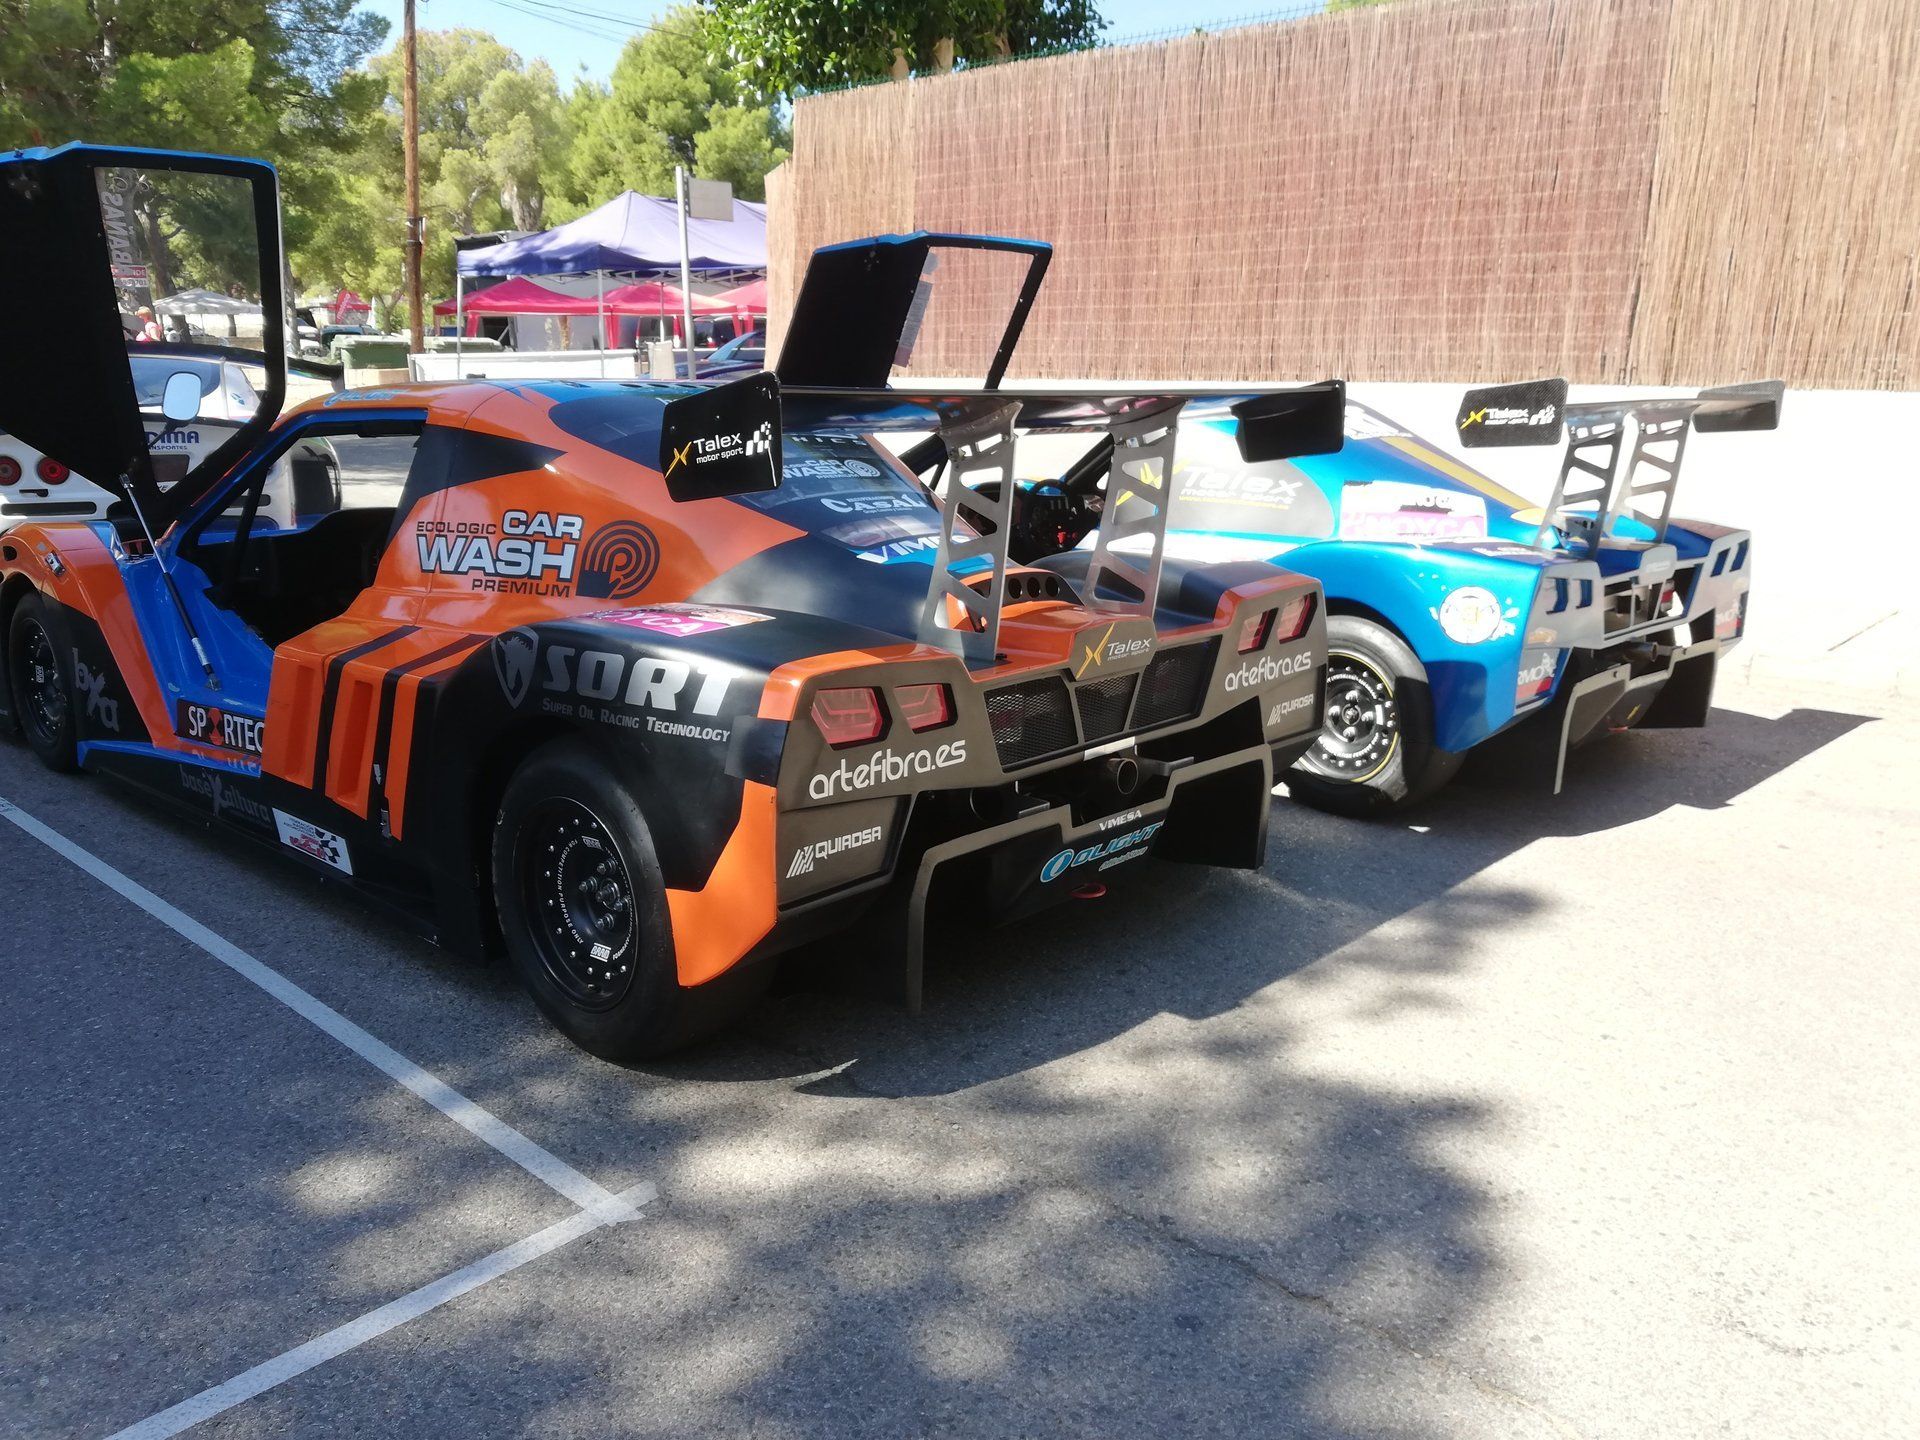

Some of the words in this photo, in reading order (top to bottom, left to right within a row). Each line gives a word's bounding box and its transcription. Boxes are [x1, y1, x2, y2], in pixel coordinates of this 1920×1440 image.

[693, 433, 742, 454] Talex
[696, 453, 720, 464] motor
[721, 447, 744, 459] sport
[1184, 466, 1303, 497] Talex
[416, 521, 497, 535] ECOLOGIC
[502, 509, 584, 541] CAR
[416, 533, 578, 582] WASH
[471, 578, 570, 598] PREMIUM
[1108, 638, 1152, 656] Talex
[542, 645, 742, 717] SORT
[1225, 651, 1311, 692] artefibra.es
[809, 740, 966, 799] artefibra.es
[1099, 810, 1142, 831] VIMESA
[1070, 819, 1165, 867] OLIGHT
